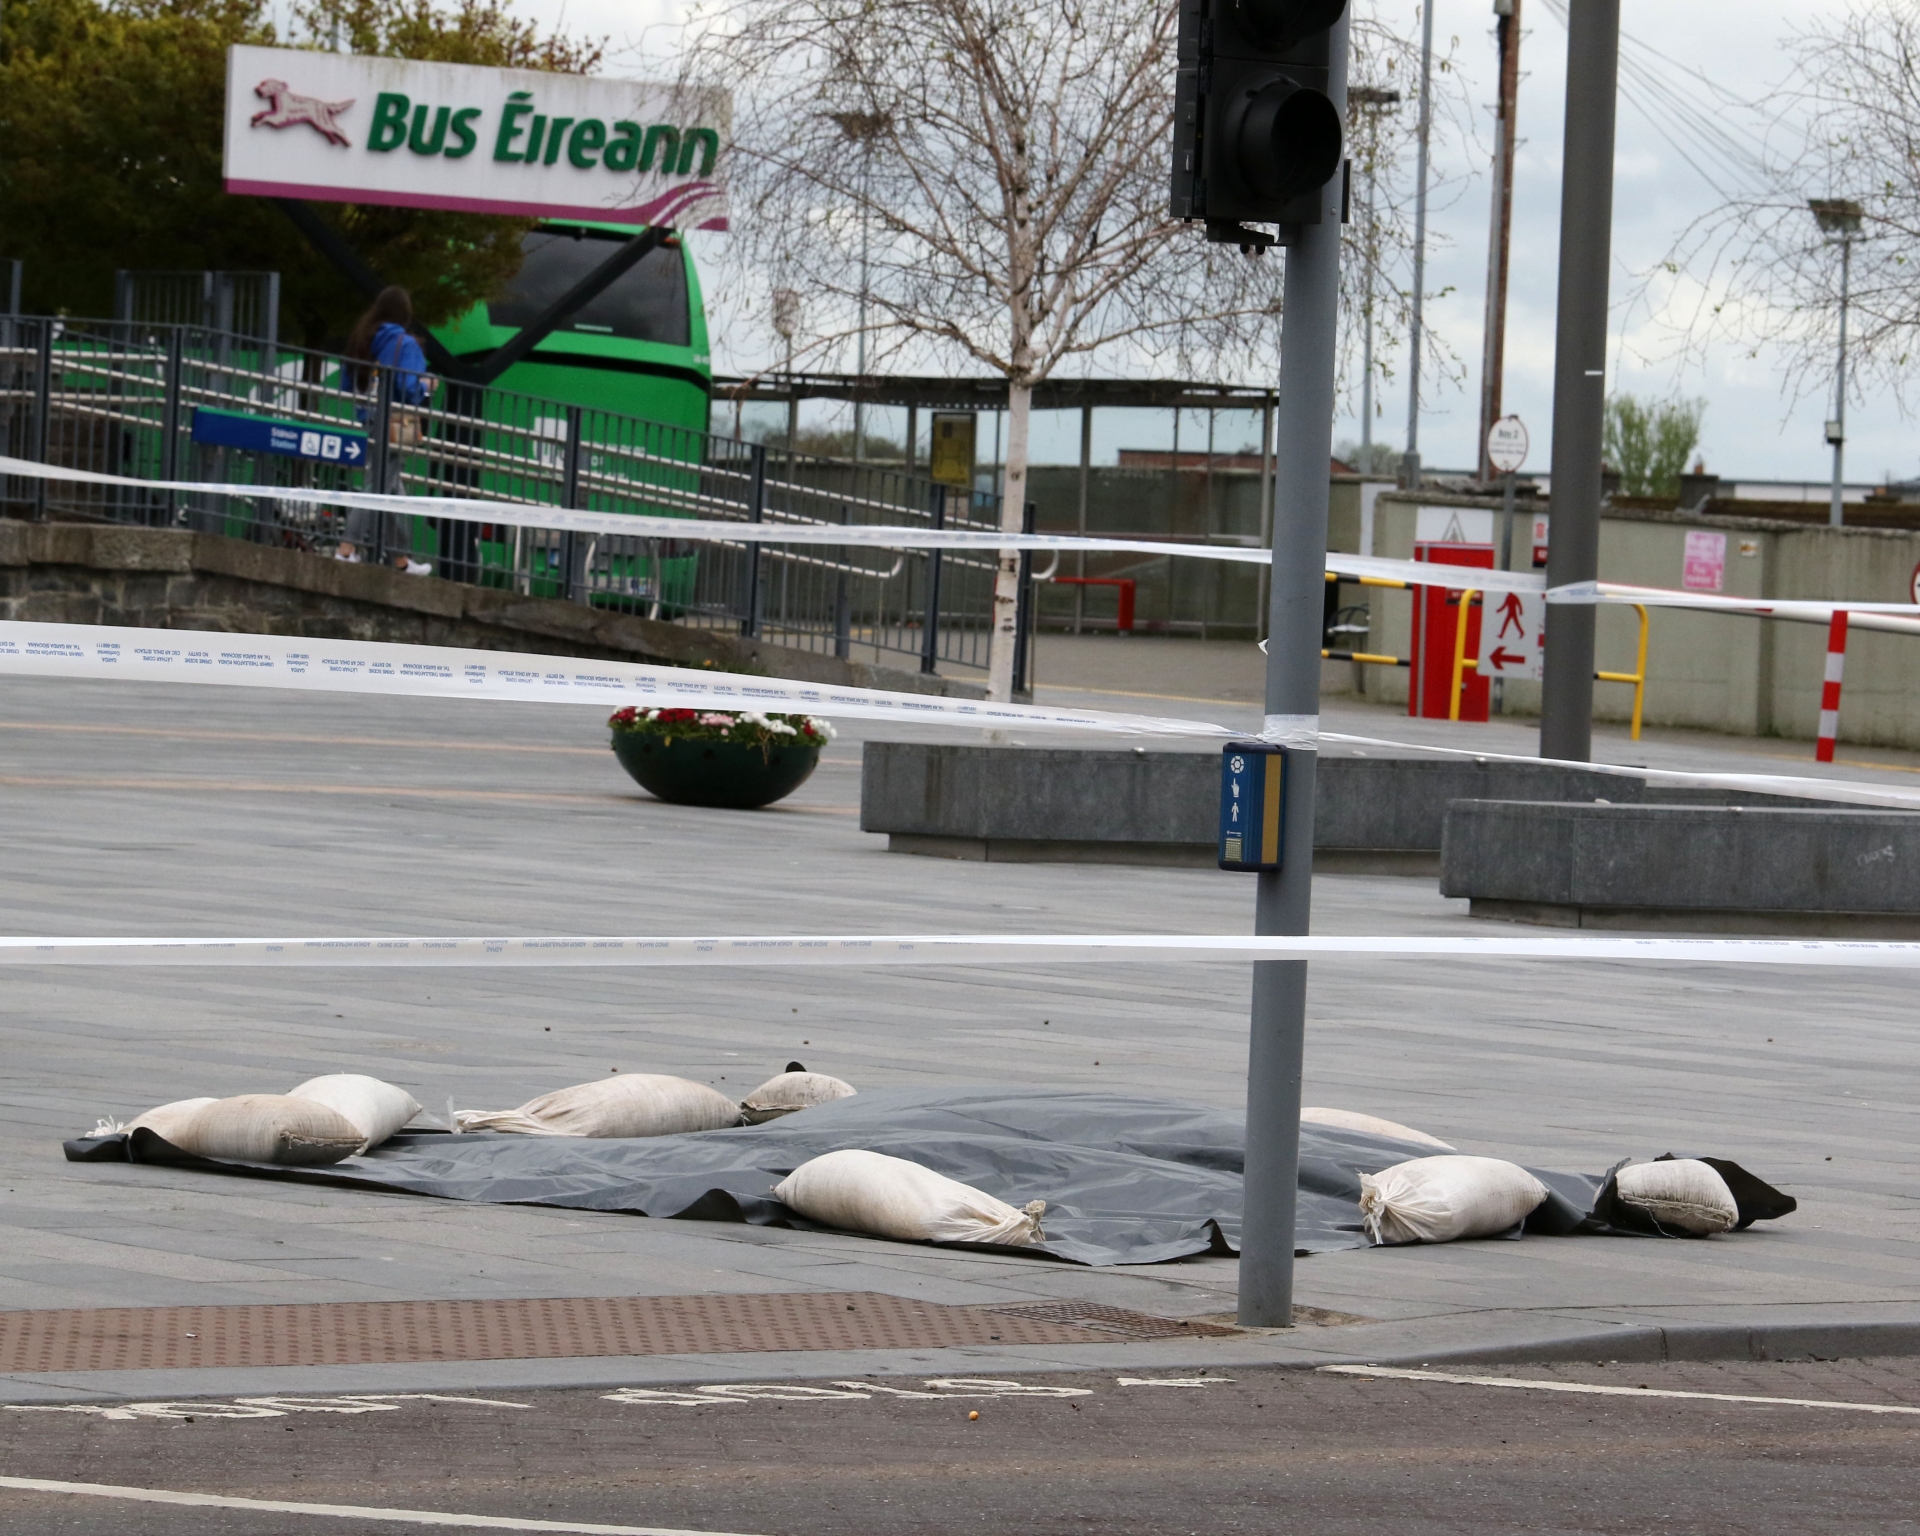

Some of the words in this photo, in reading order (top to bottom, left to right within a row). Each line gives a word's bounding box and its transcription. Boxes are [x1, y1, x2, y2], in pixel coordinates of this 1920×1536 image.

[367, 92, 482, 158] Bus
[493, 92, 718, 176] Éireann
[271, 438, 296, 449] Station
[600, 1378, 1094, 1406] STOP
